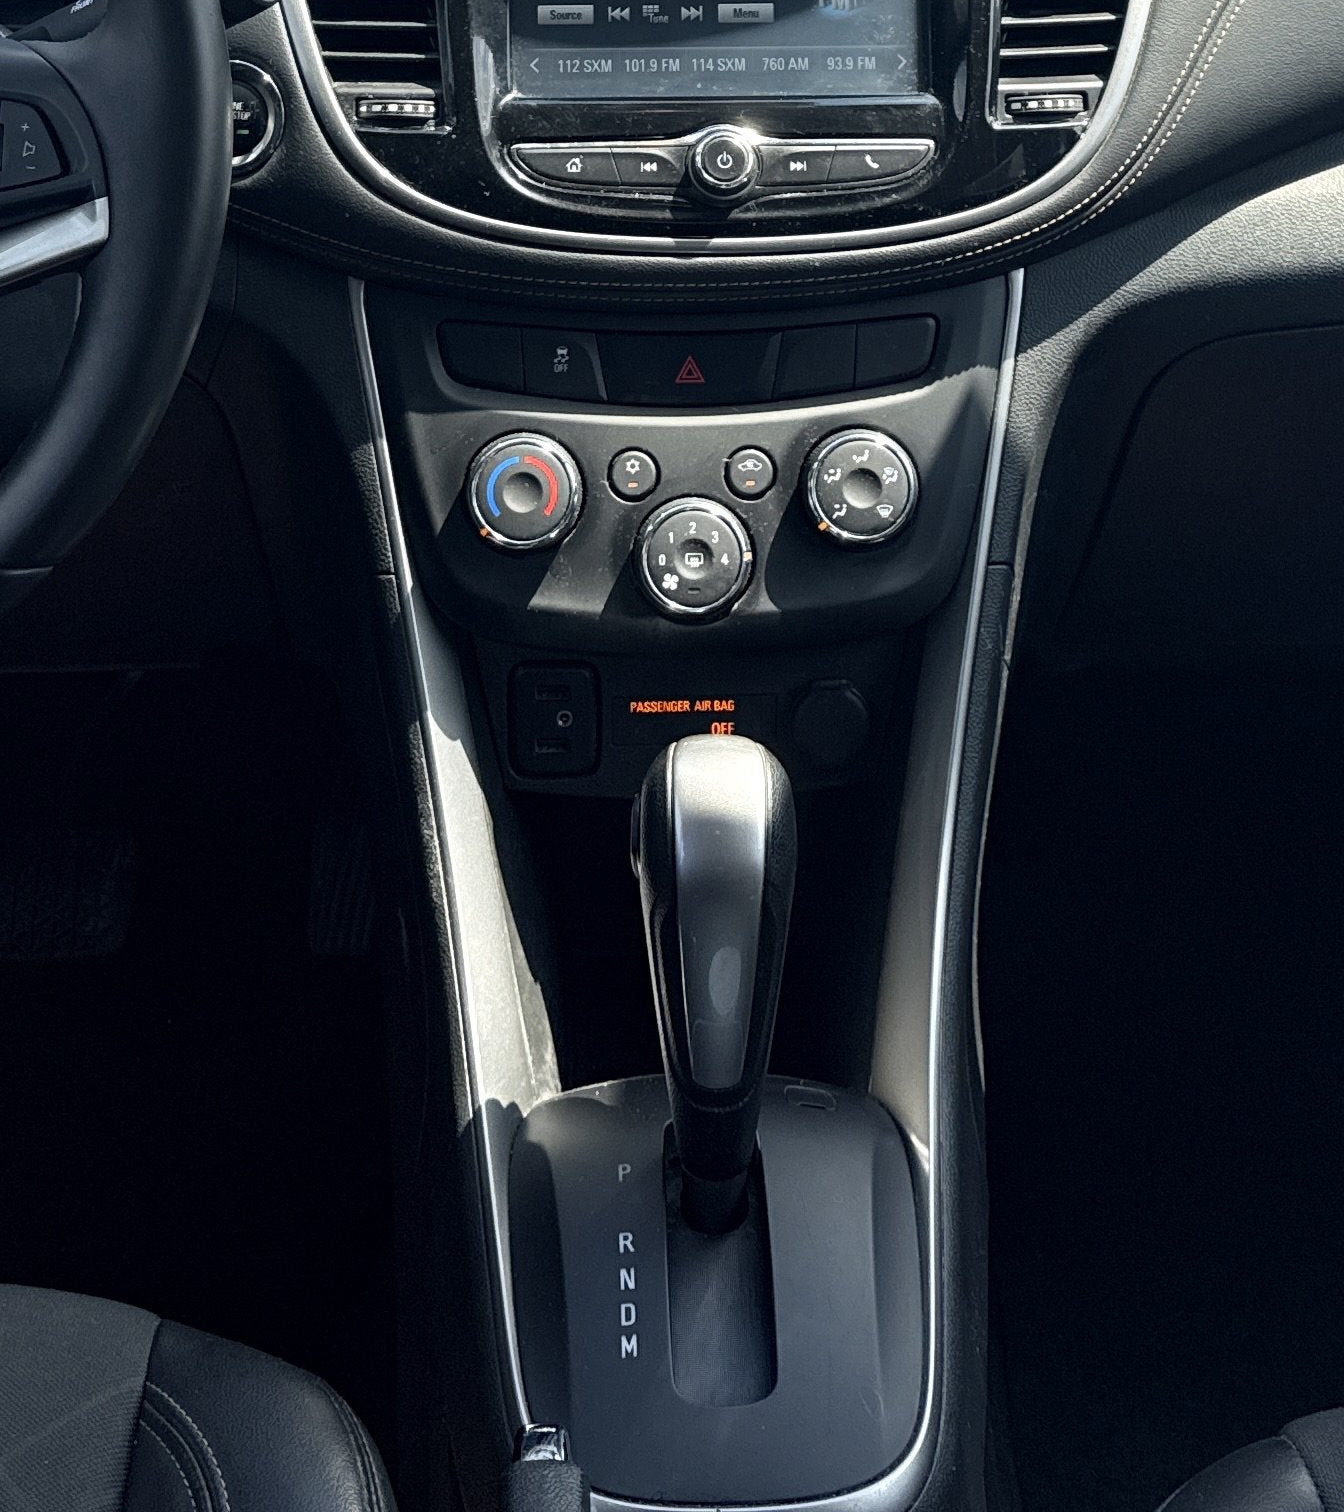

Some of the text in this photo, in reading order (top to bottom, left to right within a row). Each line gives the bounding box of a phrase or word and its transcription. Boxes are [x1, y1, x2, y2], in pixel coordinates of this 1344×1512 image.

[550, 10, 582, 21] Source
[733, 8, 759, 19] Menu
[558, 59, 612, 73] 112 SXM
[624, 59, 680, 73] 101.9 FM
[691, 58, 746, 72] 114 SXM
[762, 57, 808, 71] 760 AM
[826, 56, 876, 71] 93.9 FM
[689, 521, 697, 534] 2
[668, 531, 674, 544] 1
[711, 530, 719, 544] 3
[658, 553, 666, 566] 0
[720, 553, 730, 566] 4
[630, 699, 735, 713] PASSENGER AIR BAG
[711, 722, 735, 735] OFF
[617, 1163, 632, 1182] P
[618, 1232, 635, 1253] R
[619, 1267, 636, 1290] N
[620, 1303, 637, 1326] D
[620, 1334, 638, 1358] M
